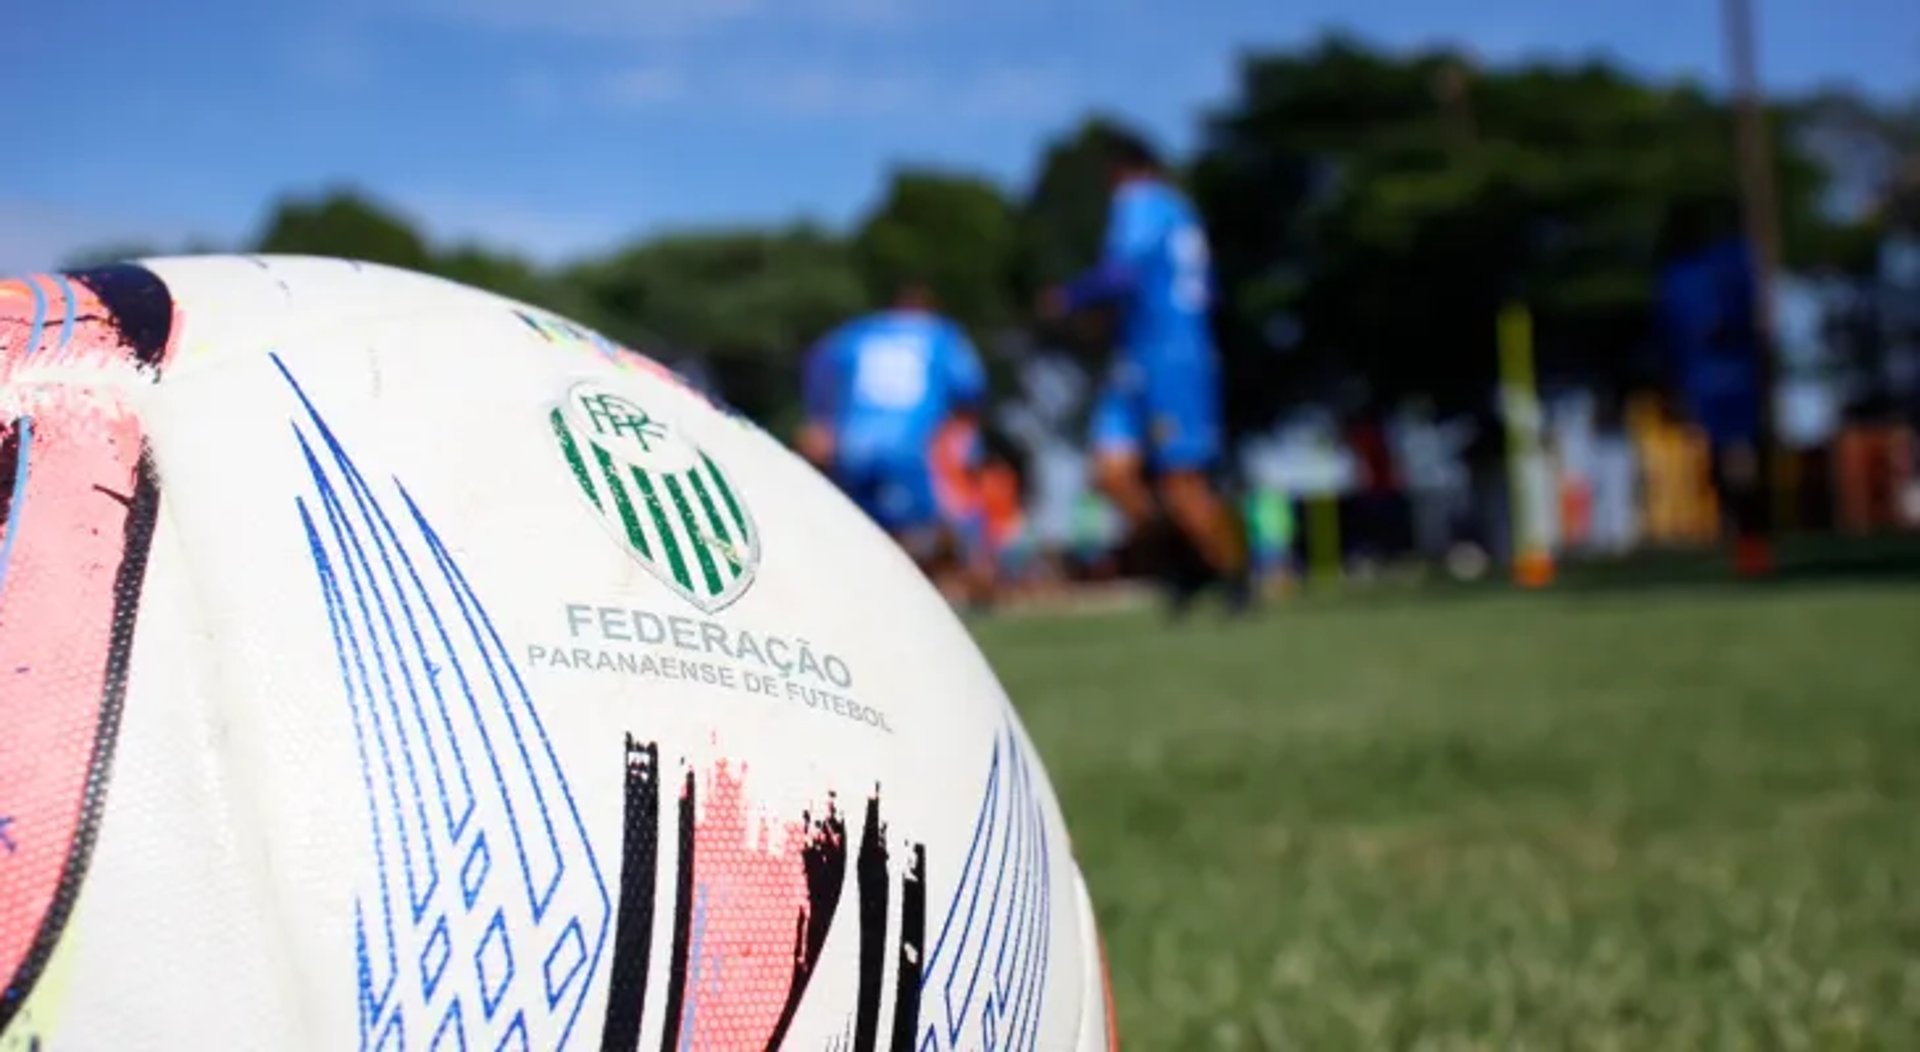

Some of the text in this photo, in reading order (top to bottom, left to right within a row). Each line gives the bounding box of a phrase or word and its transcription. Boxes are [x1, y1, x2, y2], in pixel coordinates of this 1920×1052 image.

[565, 603, 852, 688] FEDERAÇÃO
[527, 645, 894, 734] PARANAENSE DE FUTEBOL
